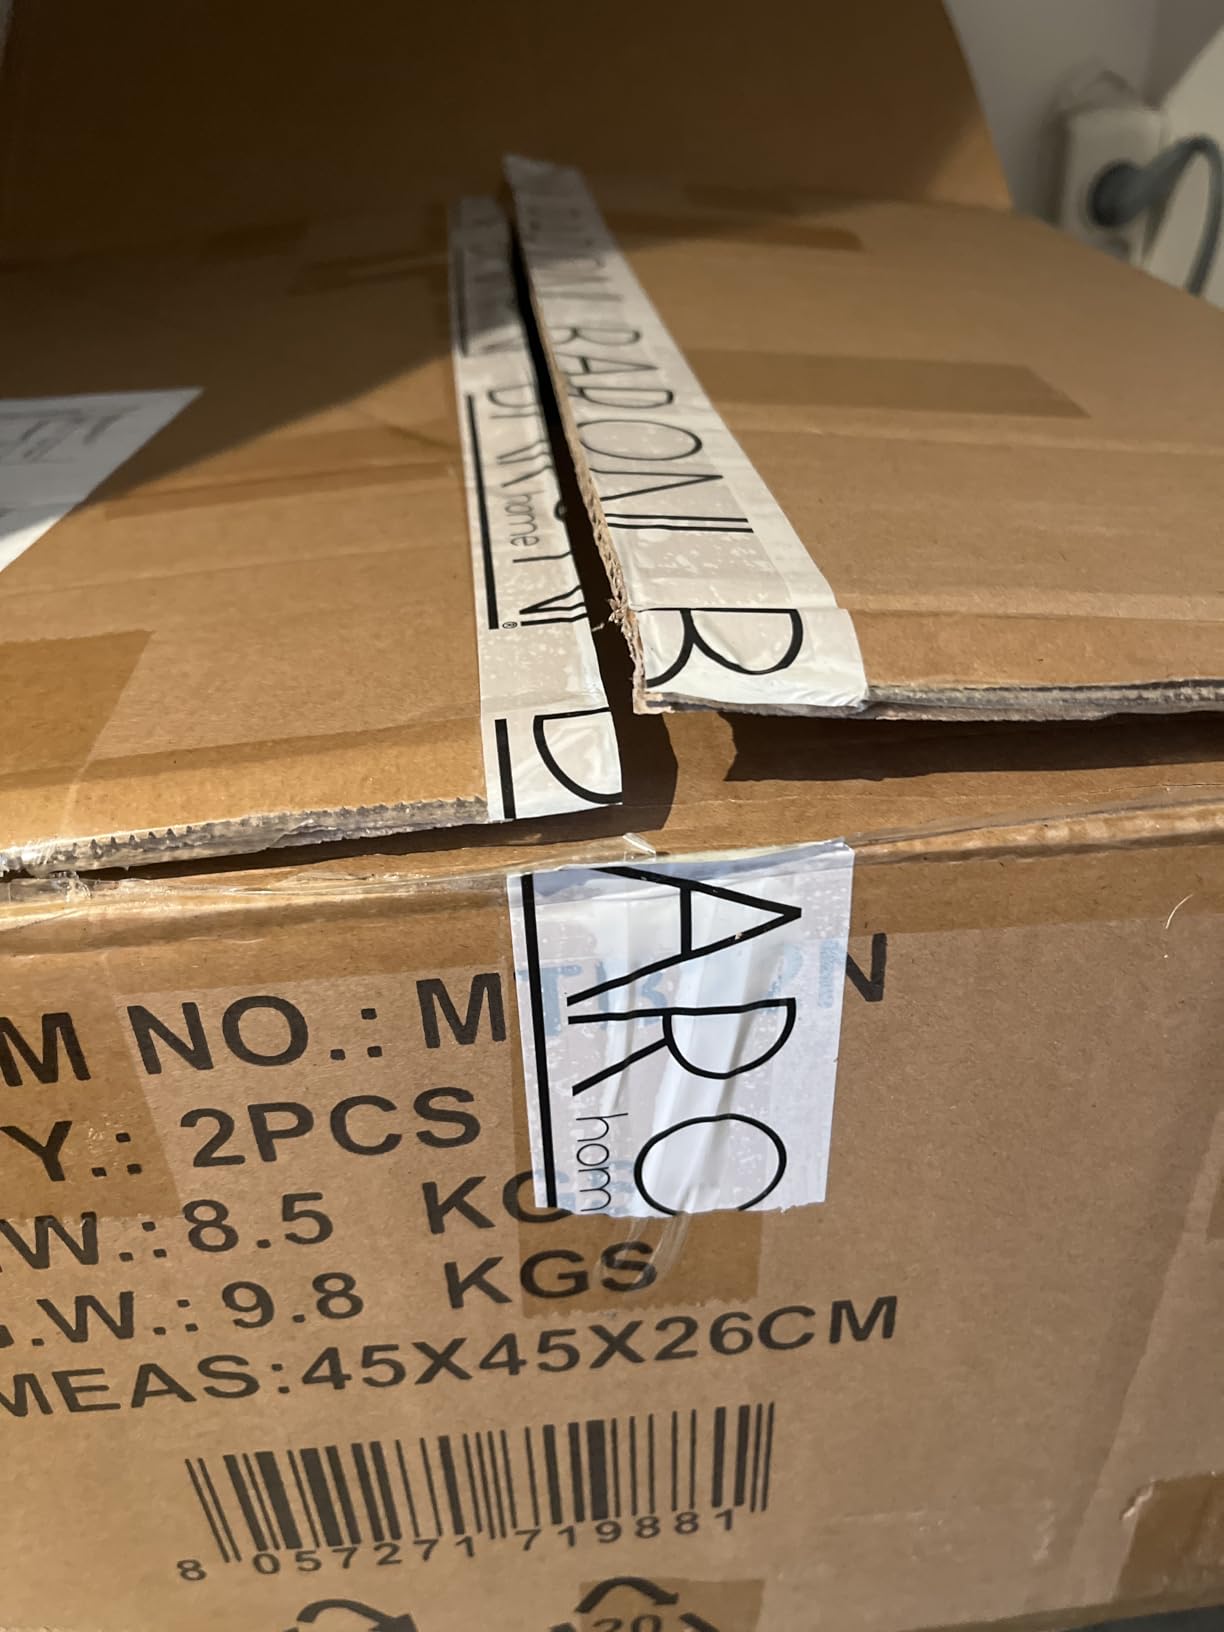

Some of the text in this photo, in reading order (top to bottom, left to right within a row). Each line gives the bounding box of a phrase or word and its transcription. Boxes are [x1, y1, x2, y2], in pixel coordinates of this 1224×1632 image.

[127, 995, 383, 1075] NO.:
[180, 1086, 481, 1168] 2PCS
[443, 1240, 658, 1309] KGS
[176, 1508, 737, 1582] 8 057271 719881
